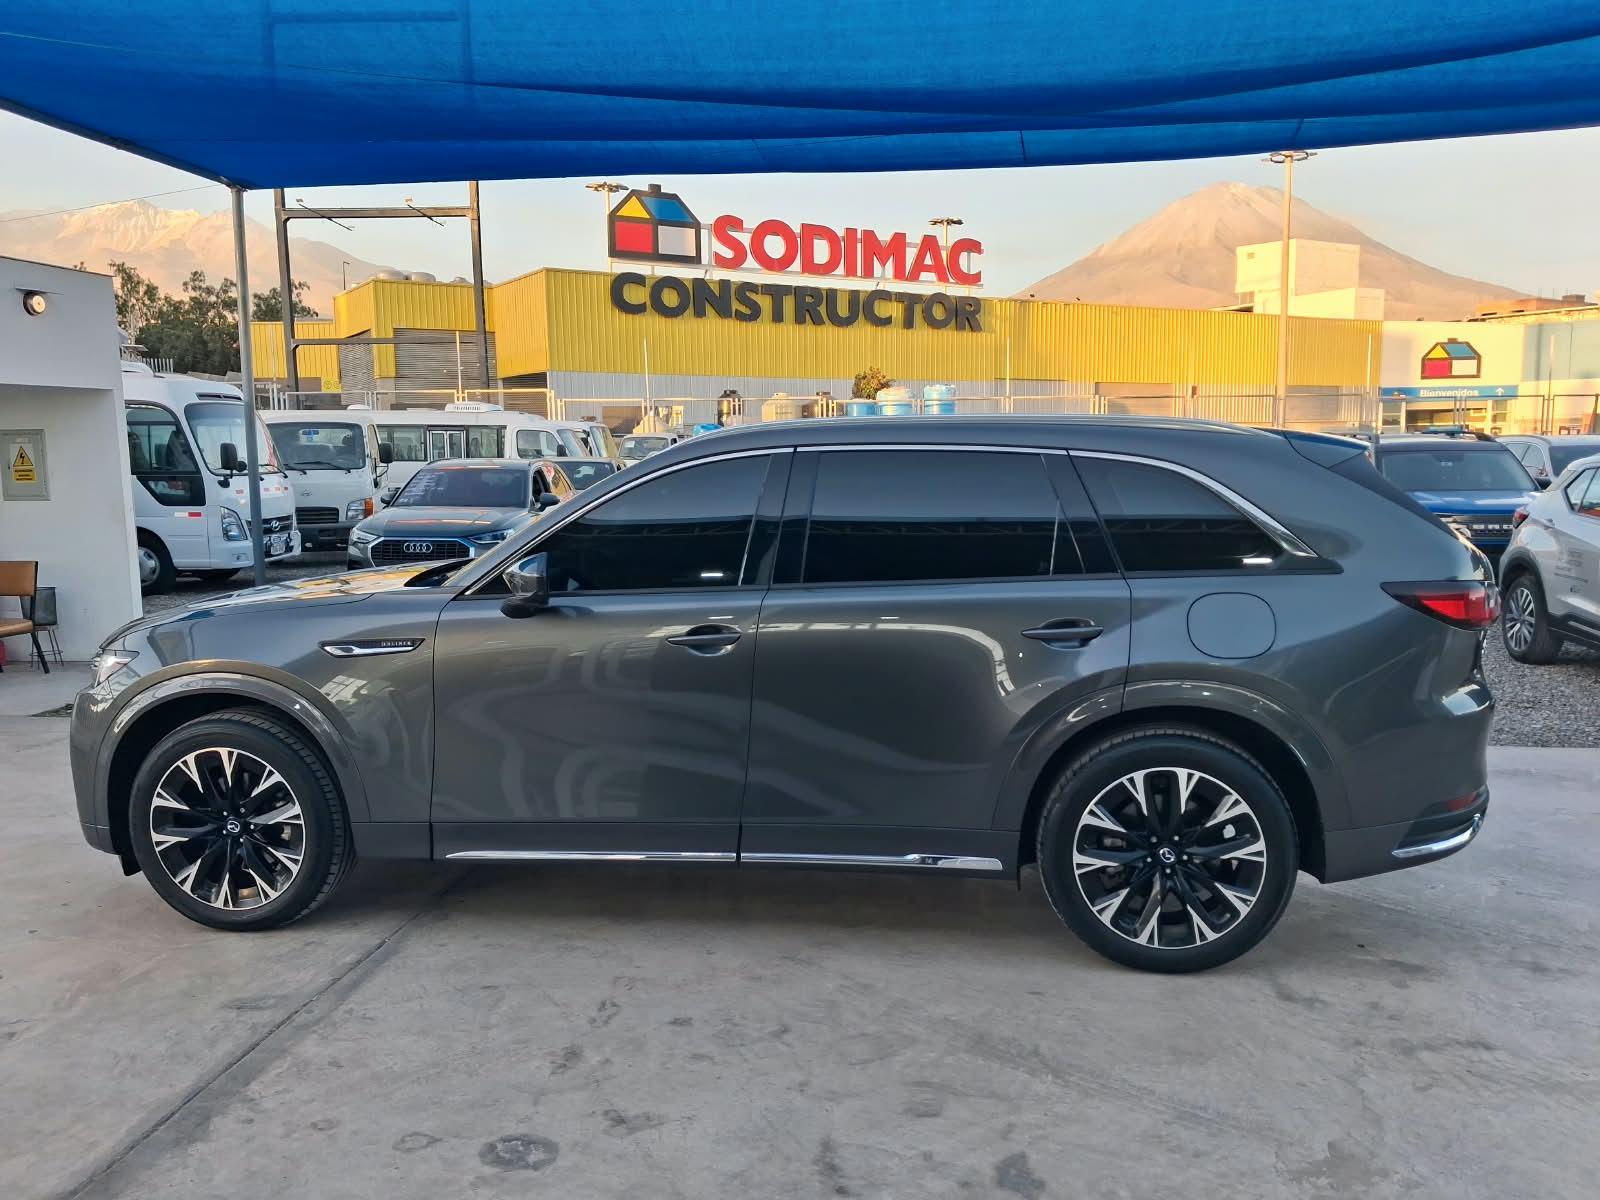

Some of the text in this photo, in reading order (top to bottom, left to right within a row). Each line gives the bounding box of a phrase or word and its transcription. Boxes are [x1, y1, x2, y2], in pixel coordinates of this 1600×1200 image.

[712, 214, 982, 286] SODIMAC
[611, 272, 982, 333] CONSTRUCTOR
[1419, 389, 1480, 397] Bienvenidos
